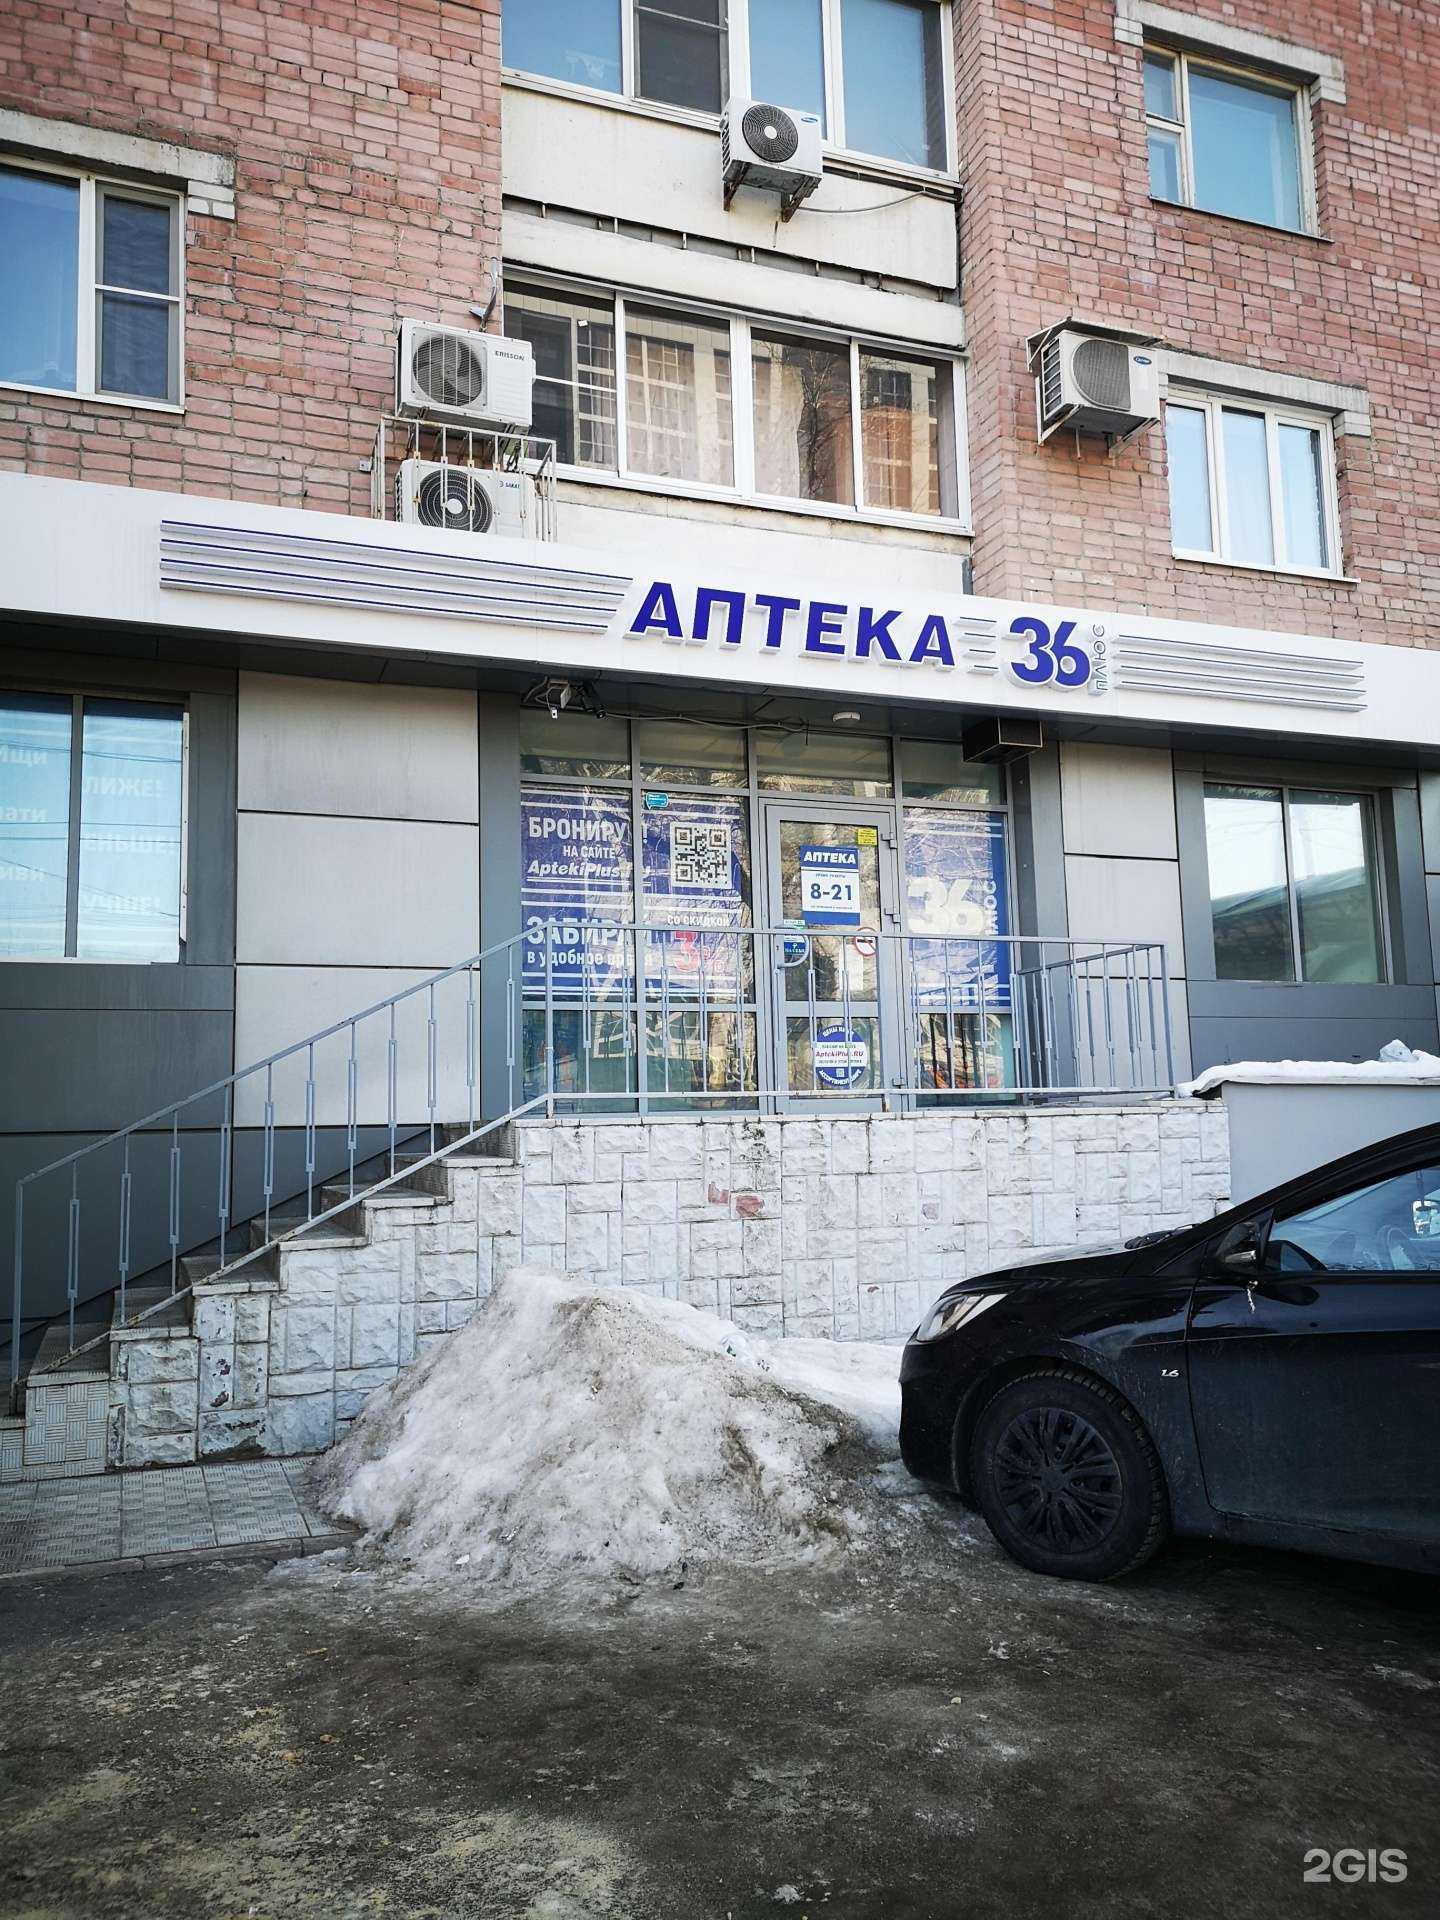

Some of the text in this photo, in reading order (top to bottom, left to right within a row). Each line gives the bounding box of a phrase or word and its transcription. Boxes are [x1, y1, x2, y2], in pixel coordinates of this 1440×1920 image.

[629, 581, 1091, 686] АПТЕКА 36
[1092, 624, 1109, 691] ПЛЮС
[529, 816, 648, 844] БРОНИРУ!
[563, 845, 616, 860] НА САЙТЕ
[803, 851, 856, 864] АПТЕКА
[810, 883, 852, 900] 8-21
[907, 878, 984, 934] 36
[528, 951, 535, 963] в
